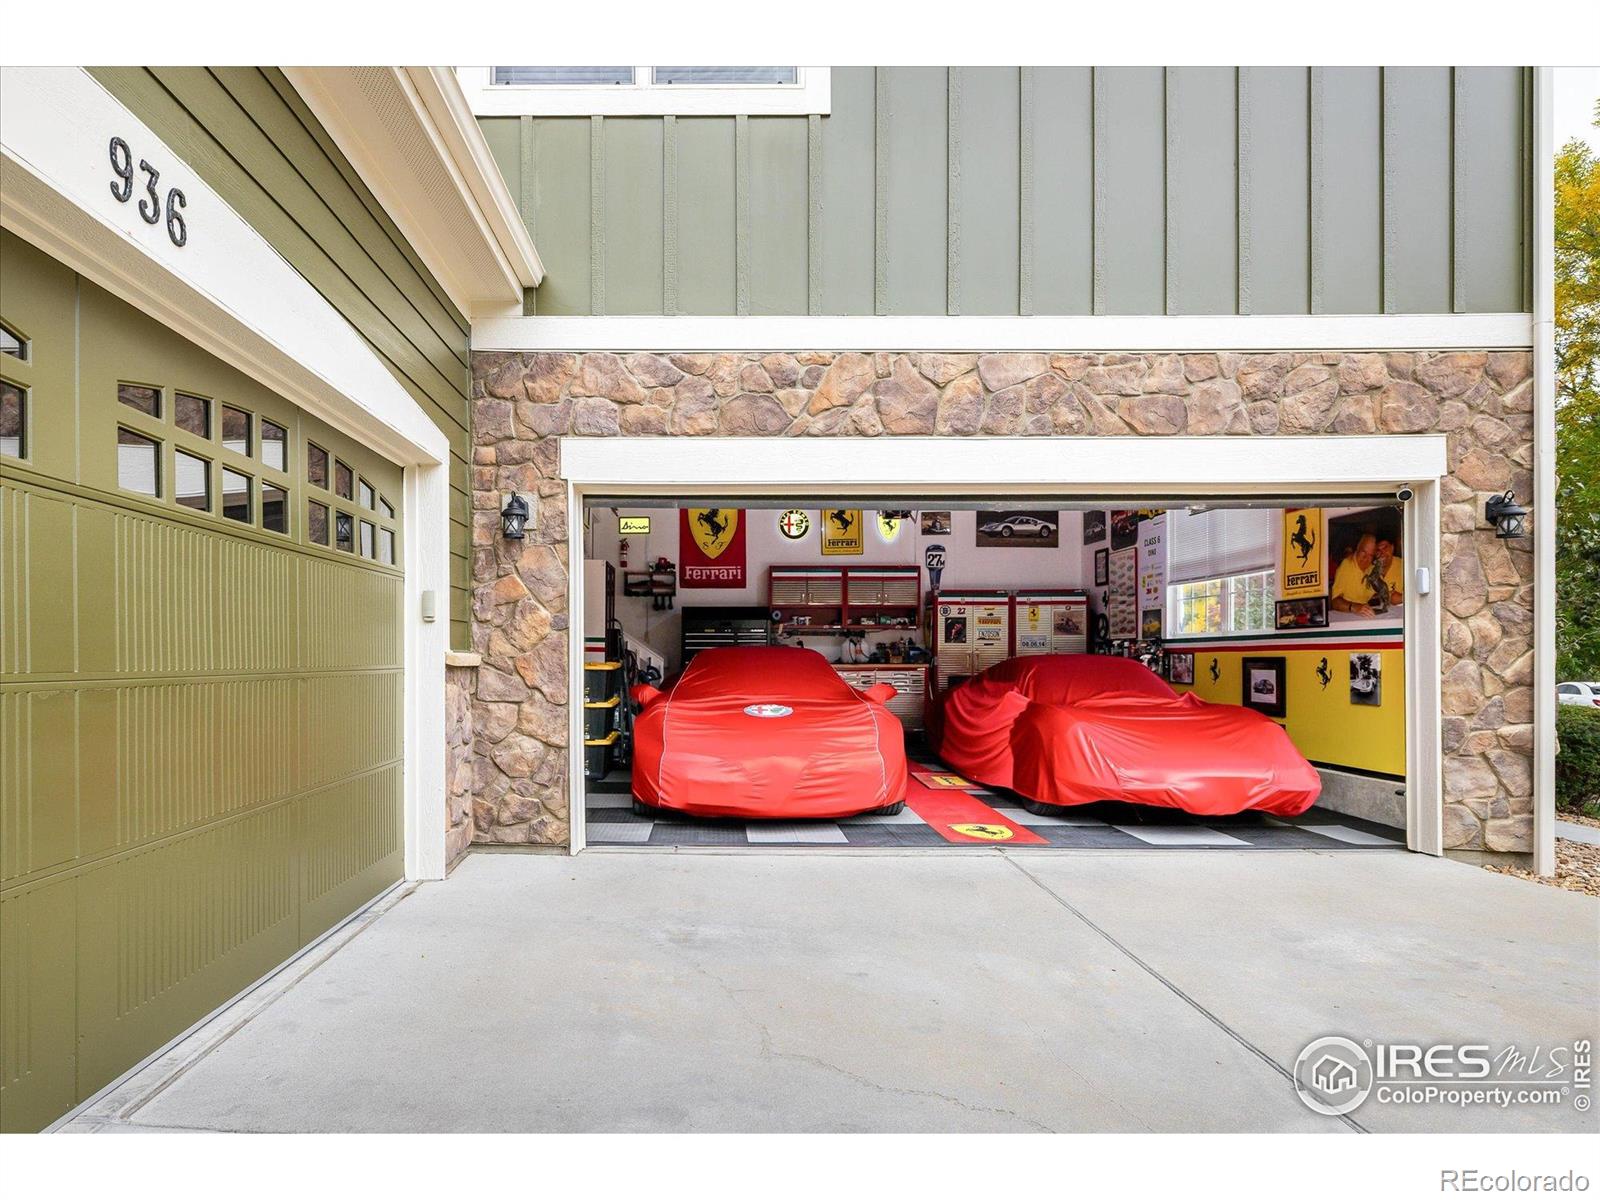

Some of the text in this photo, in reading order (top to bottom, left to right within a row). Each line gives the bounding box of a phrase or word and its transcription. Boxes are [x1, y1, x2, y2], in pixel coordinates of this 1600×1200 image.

[109, 136, 188, 248] 936
[621, 521, 648, 530] Dino
[827, 538, 858, 547] Ferrari
[1143, 536, 1157, 547] CLASS
[684, 565, 742, 580] Ferrari
[1286, 570, 1318, 587] Ferrari
